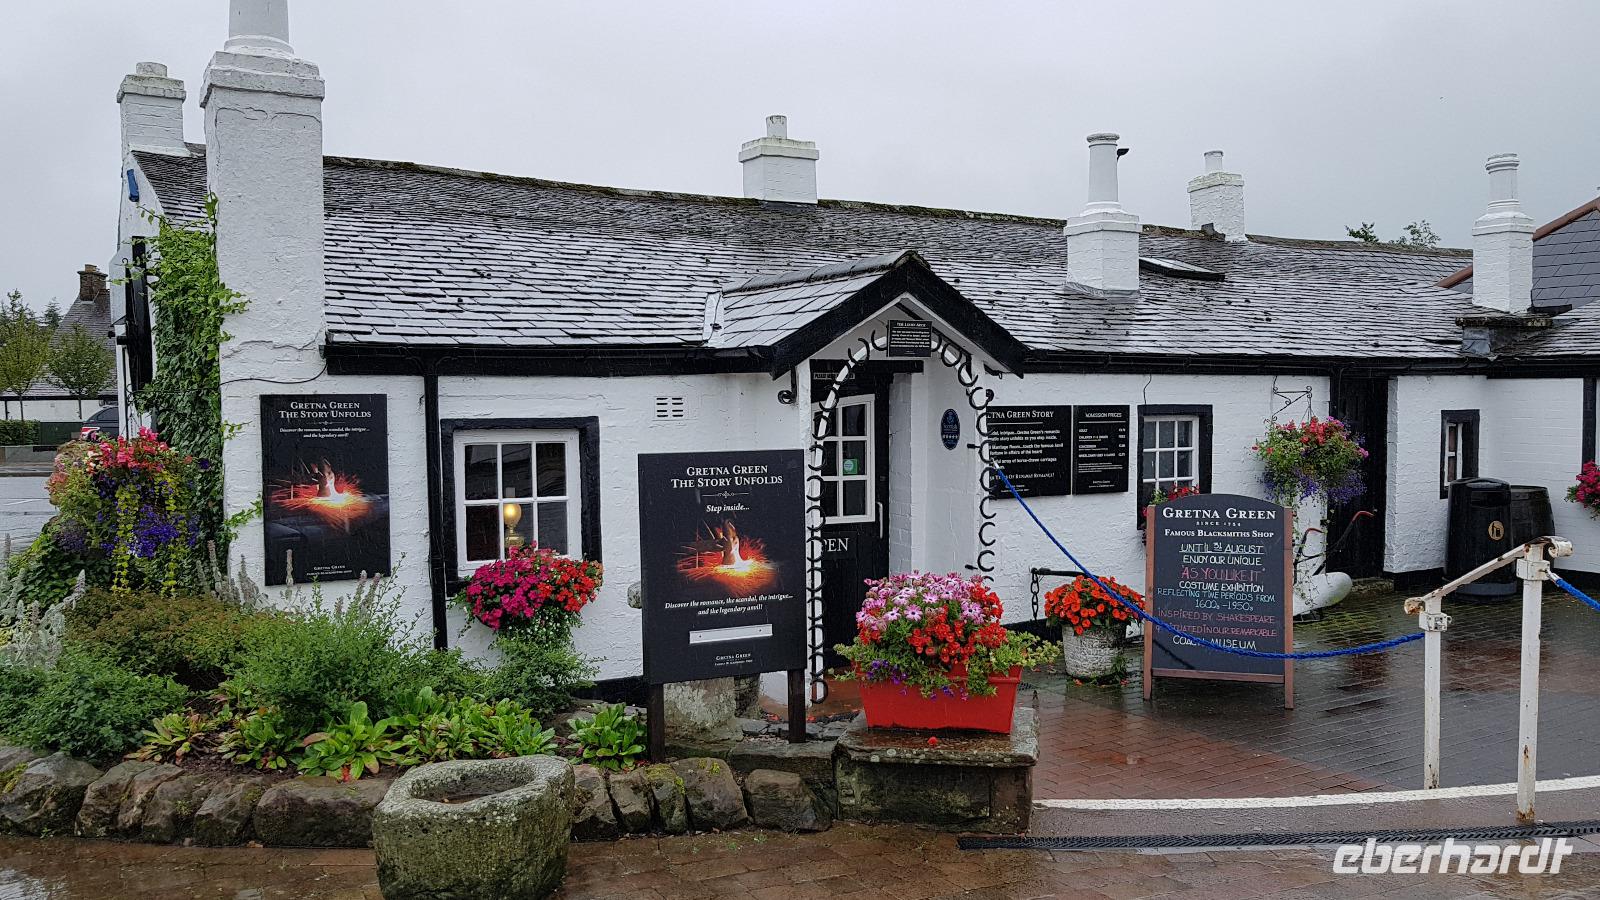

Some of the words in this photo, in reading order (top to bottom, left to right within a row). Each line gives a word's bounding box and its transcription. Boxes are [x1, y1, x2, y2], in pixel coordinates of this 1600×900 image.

[290, 401, 327, 410] GRETNA
[329, 401, 360, 409] GREEN
[279, 410, 299, 419] THE
[300, 410, 329, 418] STORY
[330, 410, 372, 418] UNFOLDS
[1007, 410, 1031, 418] GREEN
[1032, 410, 1054, 418] STORY
[686, 466, 730, 476] GRETNA
[732, 465, 768, 475] GREEN
[670, 478, 695, 488] THE
[697, 477, 732, 488] STORY
[734, 475, 783, 486] UNFOLDS
[706, 504, 722, 513] Step
[1162, 507, 1220, 519] GRETNA
[1225, 507, 1276, 520] GREEN
[1164, 528, 1195, 537] FAMOUS
[1197, 529, 1250, 538] BLACKSMITHS
[1252, 530, 1274, 538] SHOP
[1180, 542, 1212, 553] UNTIL
[1224, 544, 1265, 554] AUGUST
[1183, 554, 1209, 564] ENJOY
[1209, 555, 1226, 564] OUR
[1227, 556, 1262, 566] UNIQUE
[1200, 567, 1224, 580] YOU
[1225, 569, 1249, 581] LIKE
[1179, 580, 1219, 591] COSTUME
[1221, 583, 1264, 593] EXHIBITION
[1157, 587, 1200, 598] REFLECTING
[1202, 590, 1219, 599] TIME
[1220, 591, 1254, 602] PERIODS
[1255, 594, 1276, 603] FROM
[719, 605, 747, 615] legendary
[1158, 608, 1200, 619] INSPIRED
[1202, 613, 1213, 621] BY
[1216, 613, 1276, 624] SHAKESPEARE
[1230, 627, 1277, 637] REMARKABLE
